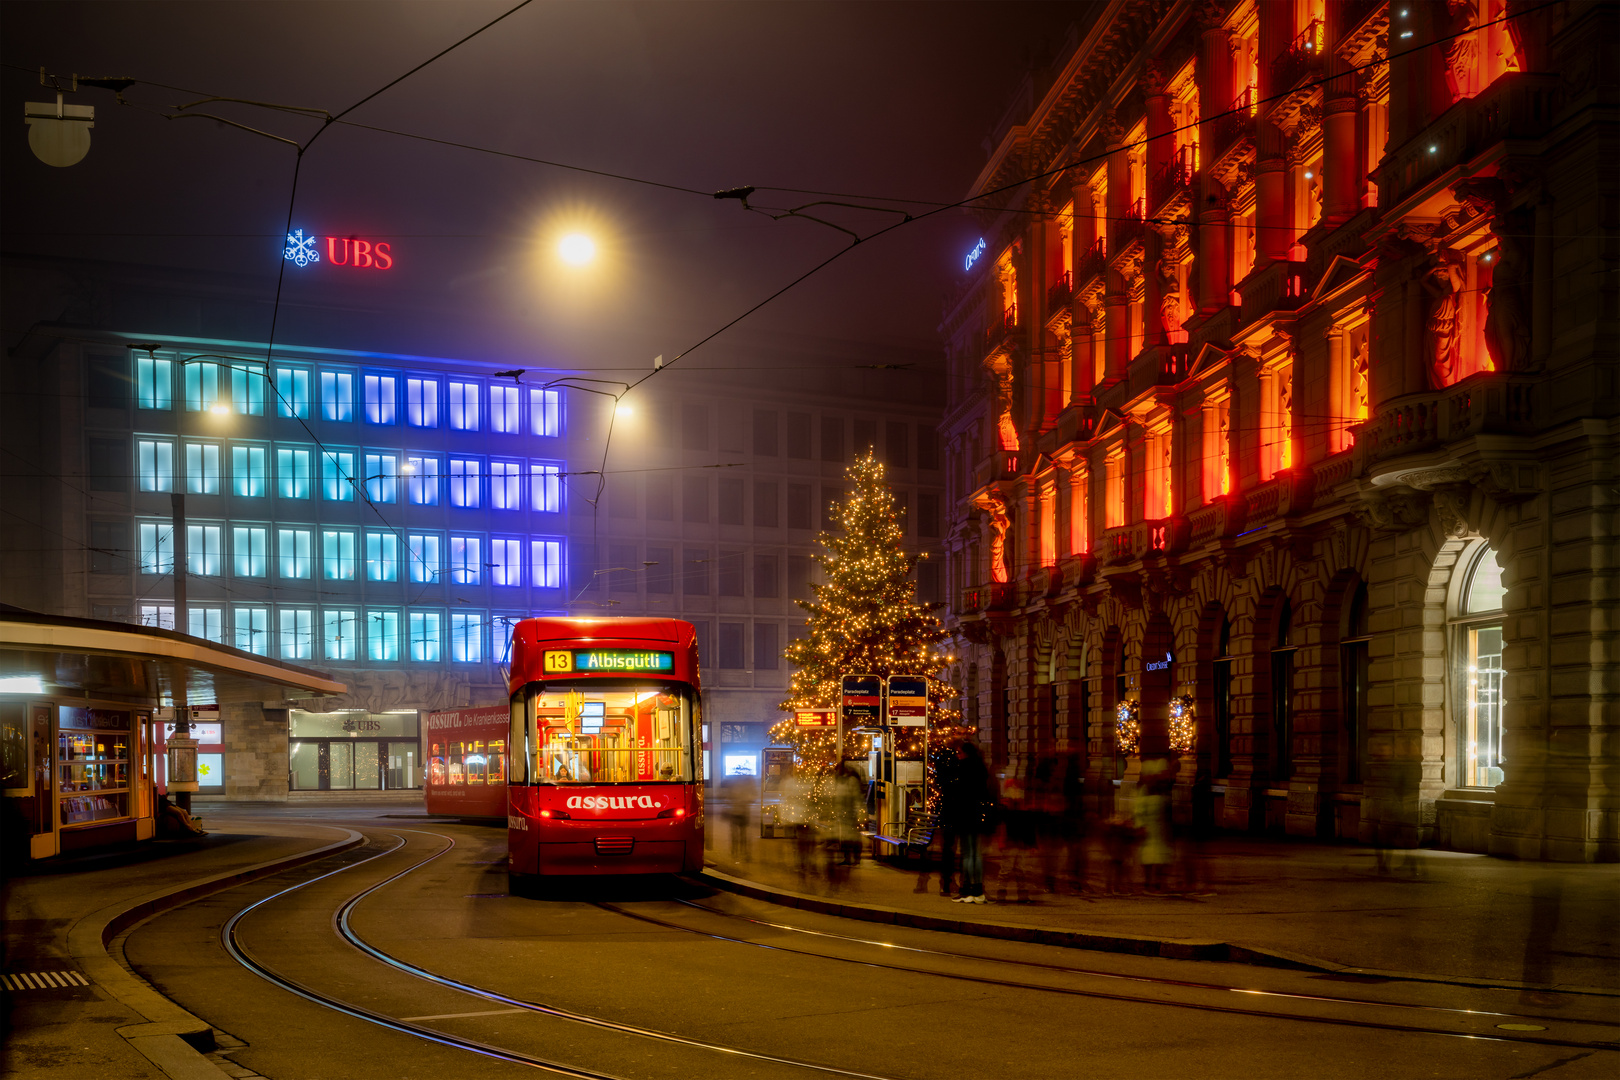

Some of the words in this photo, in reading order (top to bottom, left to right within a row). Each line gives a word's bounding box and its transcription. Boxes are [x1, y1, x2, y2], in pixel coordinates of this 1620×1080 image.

[326, 236, 393, 270] UBS
[549, 654, 568, 669] 13
[588, 653, 661, 670] Albisgütli
[357, 720, 381, 731] UBS
[429, 712, 462, 730] assura.
[463, 714, 473, 727] Die
[473, 711, 510, 726] Krankenkasse
[567, 794, 661, 809] assura.
